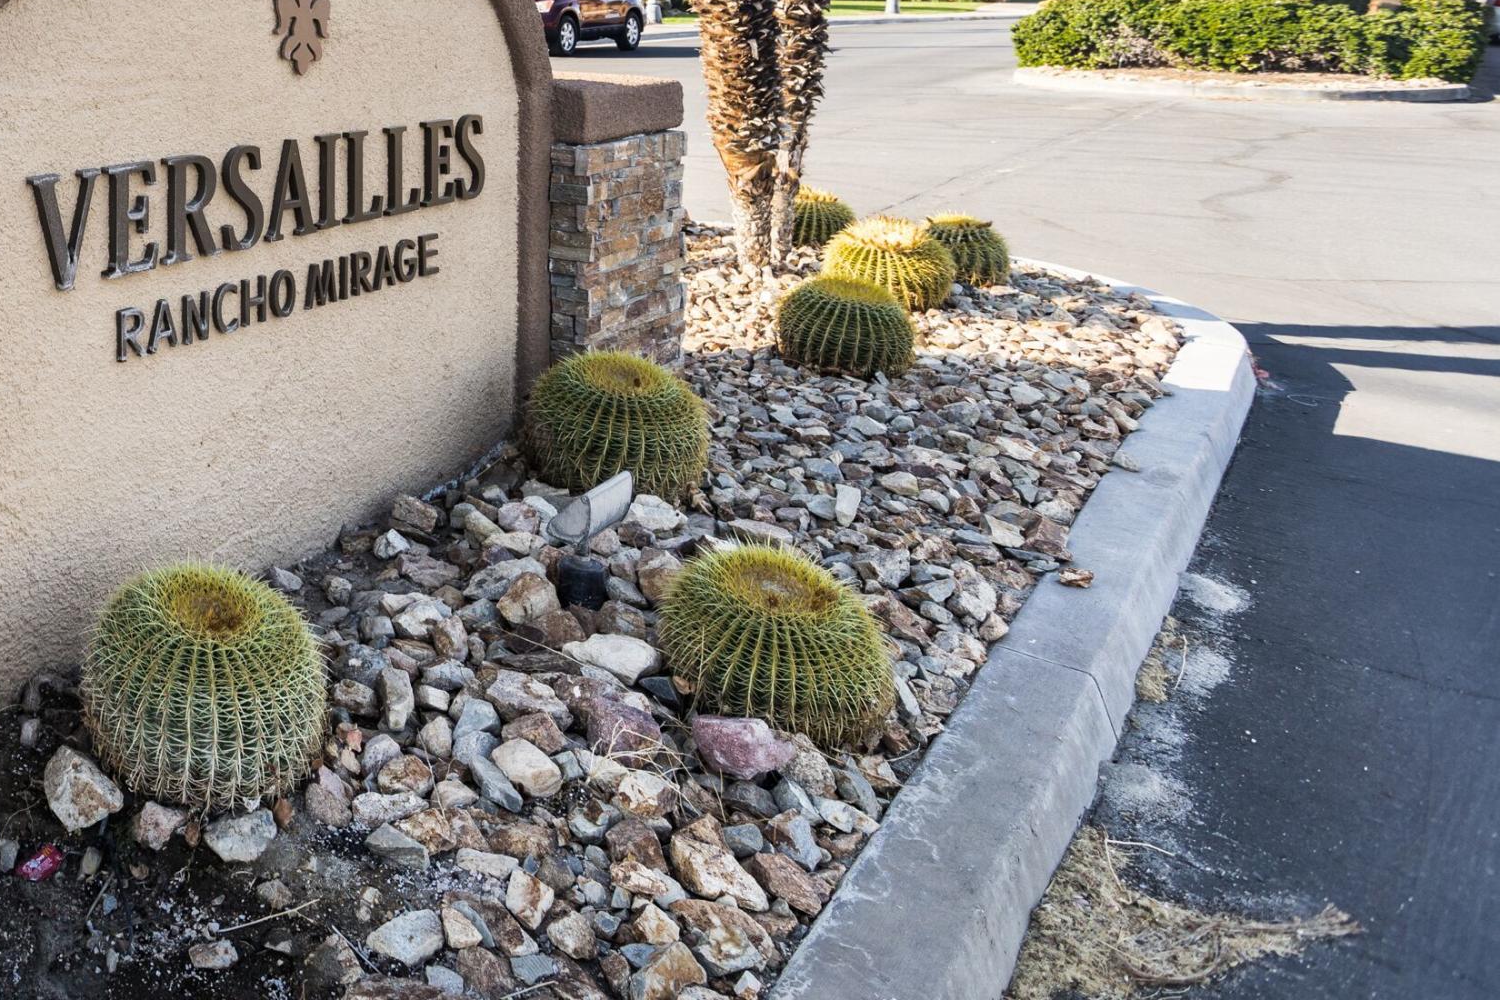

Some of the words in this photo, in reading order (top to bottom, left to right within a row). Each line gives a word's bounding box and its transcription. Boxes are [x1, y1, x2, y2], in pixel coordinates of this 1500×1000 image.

[26, 114, 486, 291] VERSAILLES
[115, 268, 297, 363] RANCHO
[303, 232, 440, 311] MIRAGE
